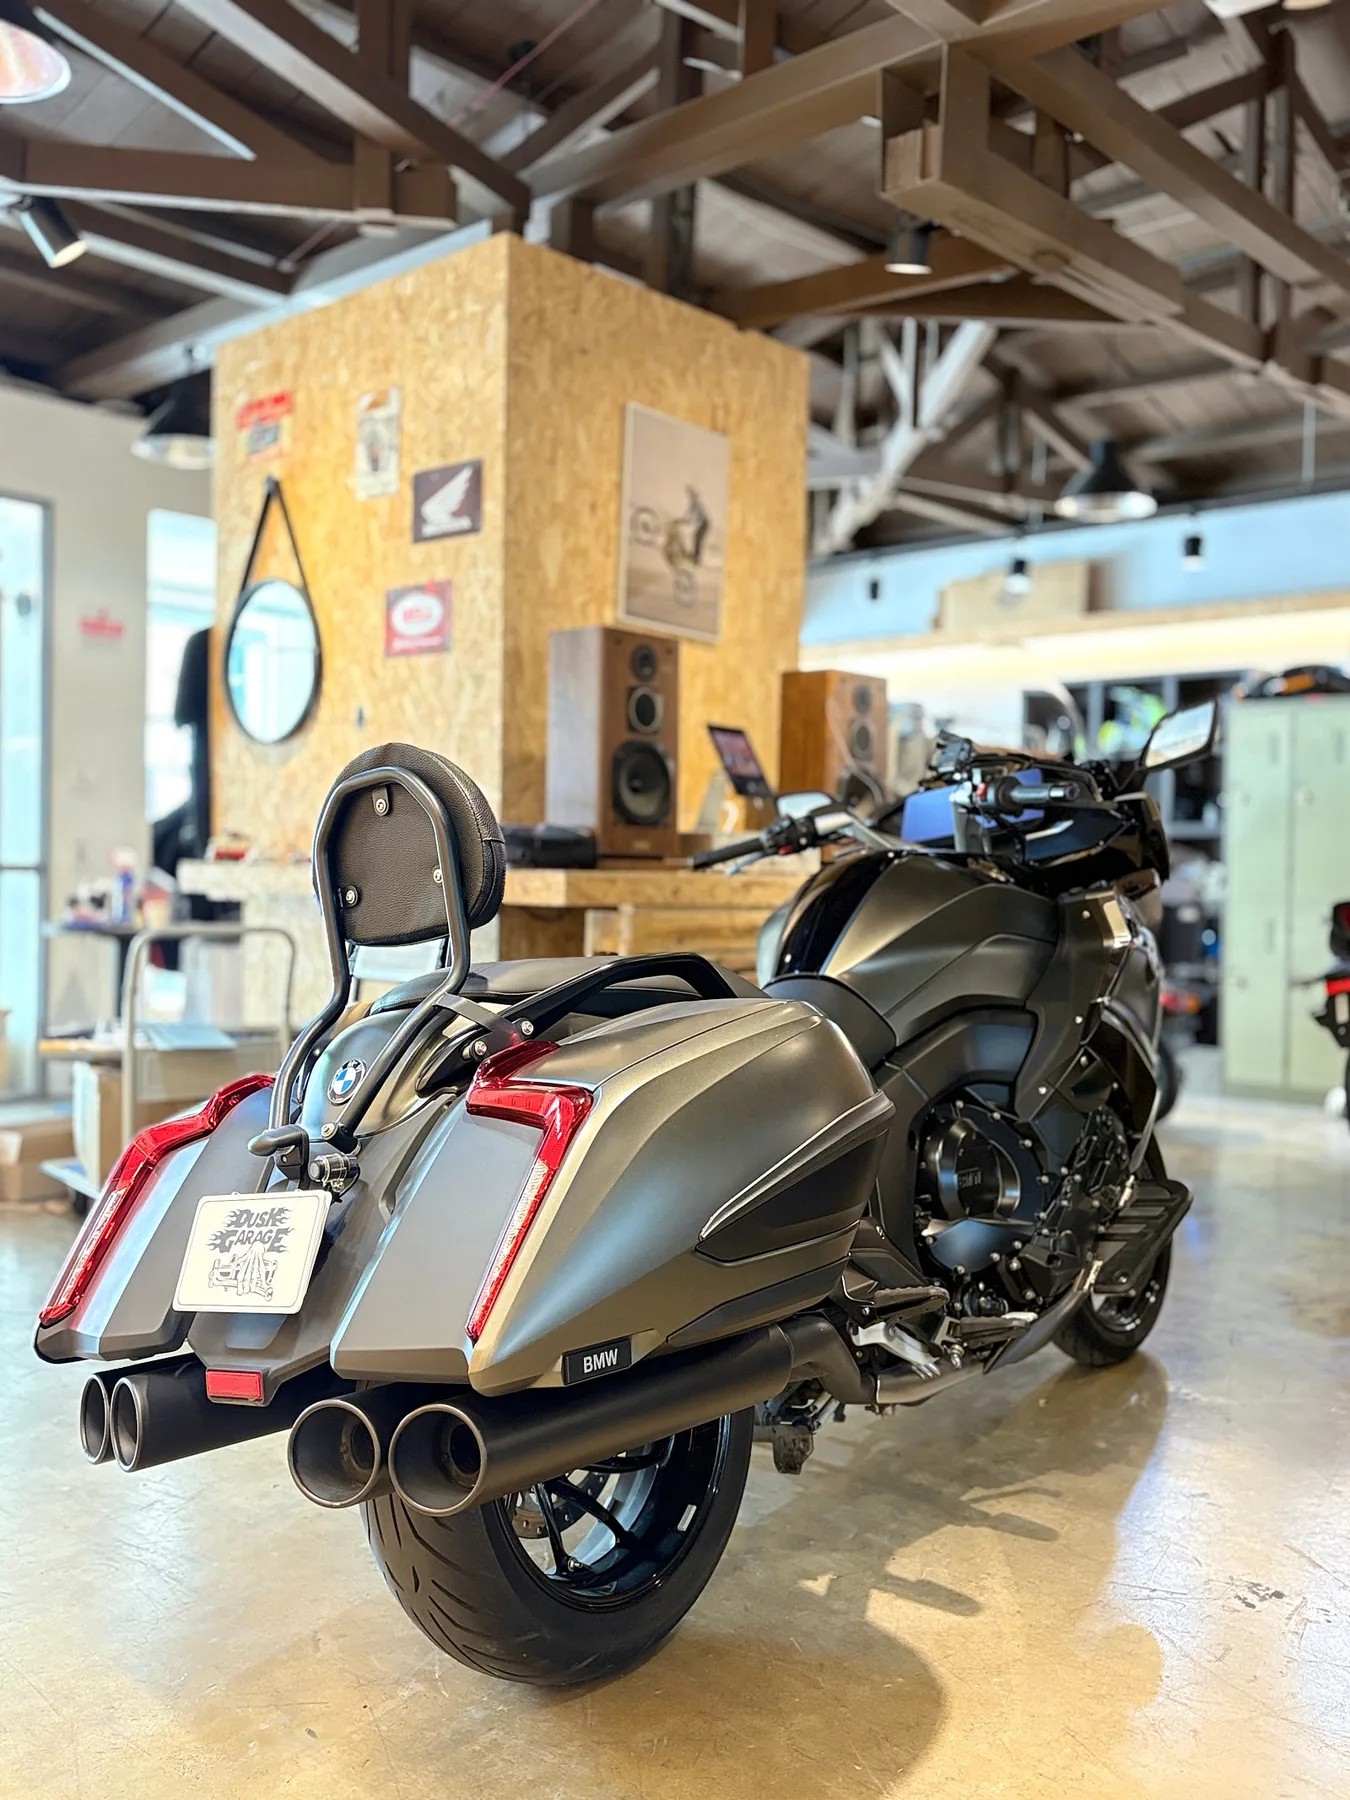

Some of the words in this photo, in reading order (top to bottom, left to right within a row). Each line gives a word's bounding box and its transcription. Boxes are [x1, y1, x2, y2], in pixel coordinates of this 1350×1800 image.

[223, 1207, 292, 1228] DUSK
[206, 1227, 295, 1253] GARAGE
[583, 1348, 618, 1374] BMW
